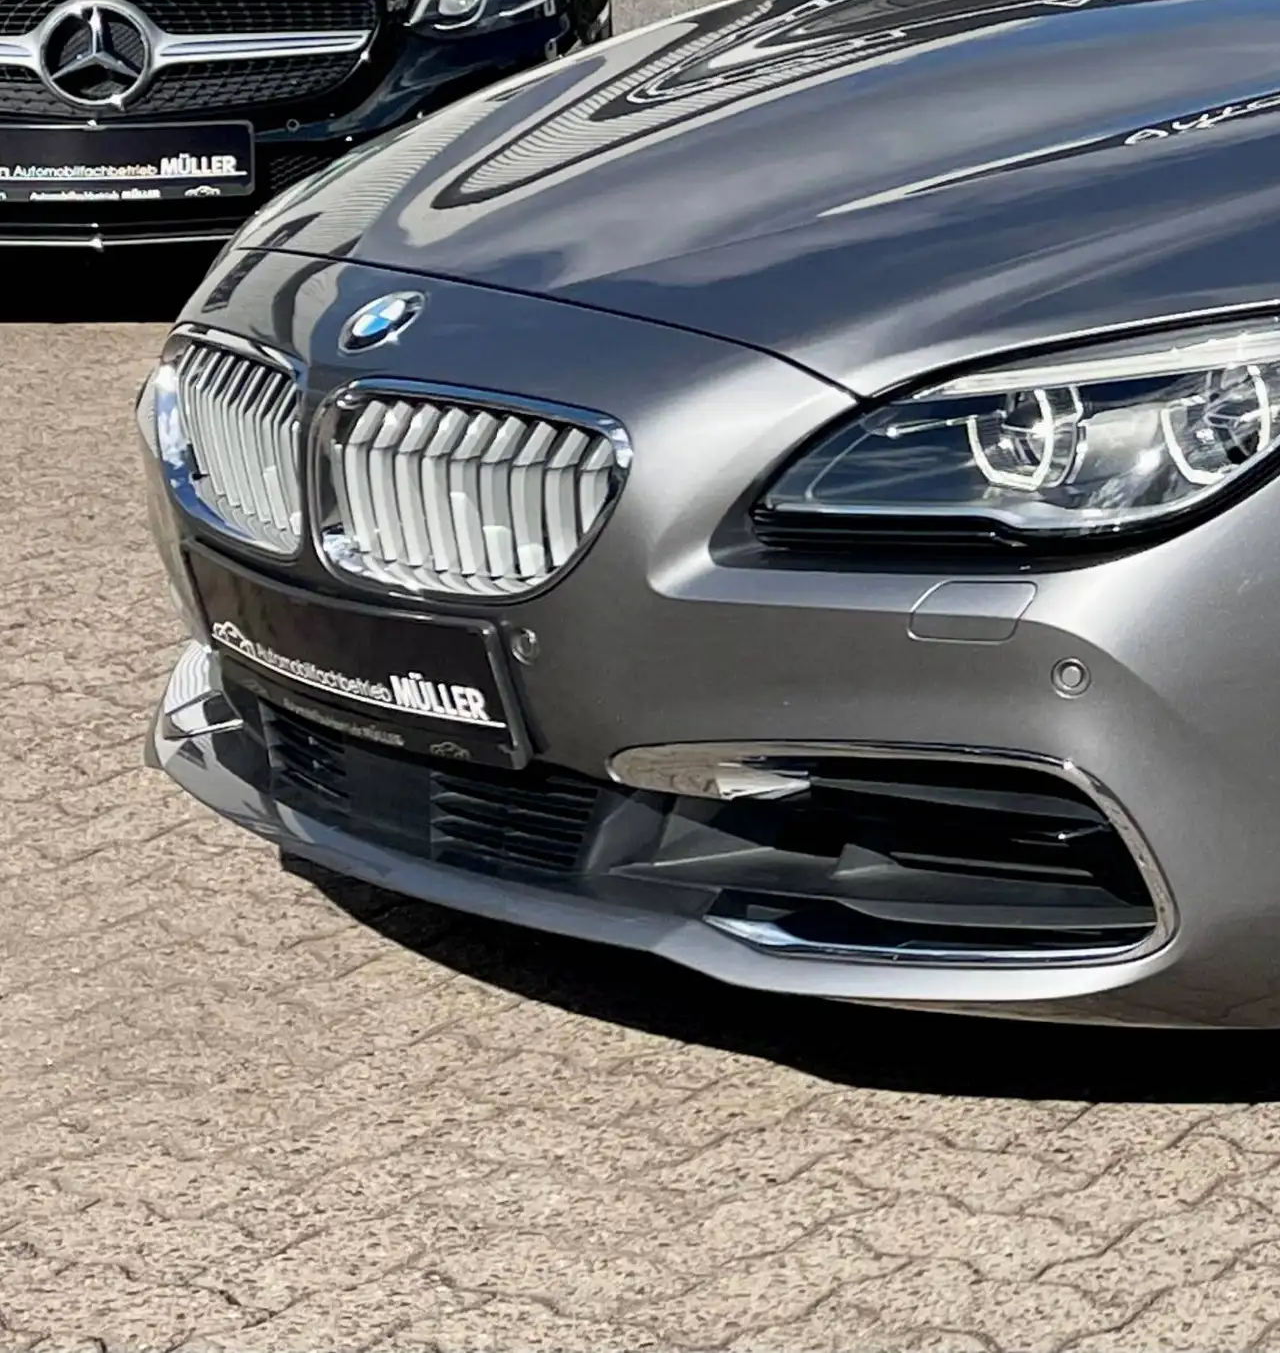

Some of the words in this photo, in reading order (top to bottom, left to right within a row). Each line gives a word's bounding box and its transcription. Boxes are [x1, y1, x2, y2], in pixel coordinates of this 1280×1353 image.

[13, 164, 158, 178] Automobilfachbetrieb
[160, 153, 237, 176] MÜLLER
[254, 642, 392, 703] Automobilfachbetrieb
[389, 672, 490, 721] MÜLLER
